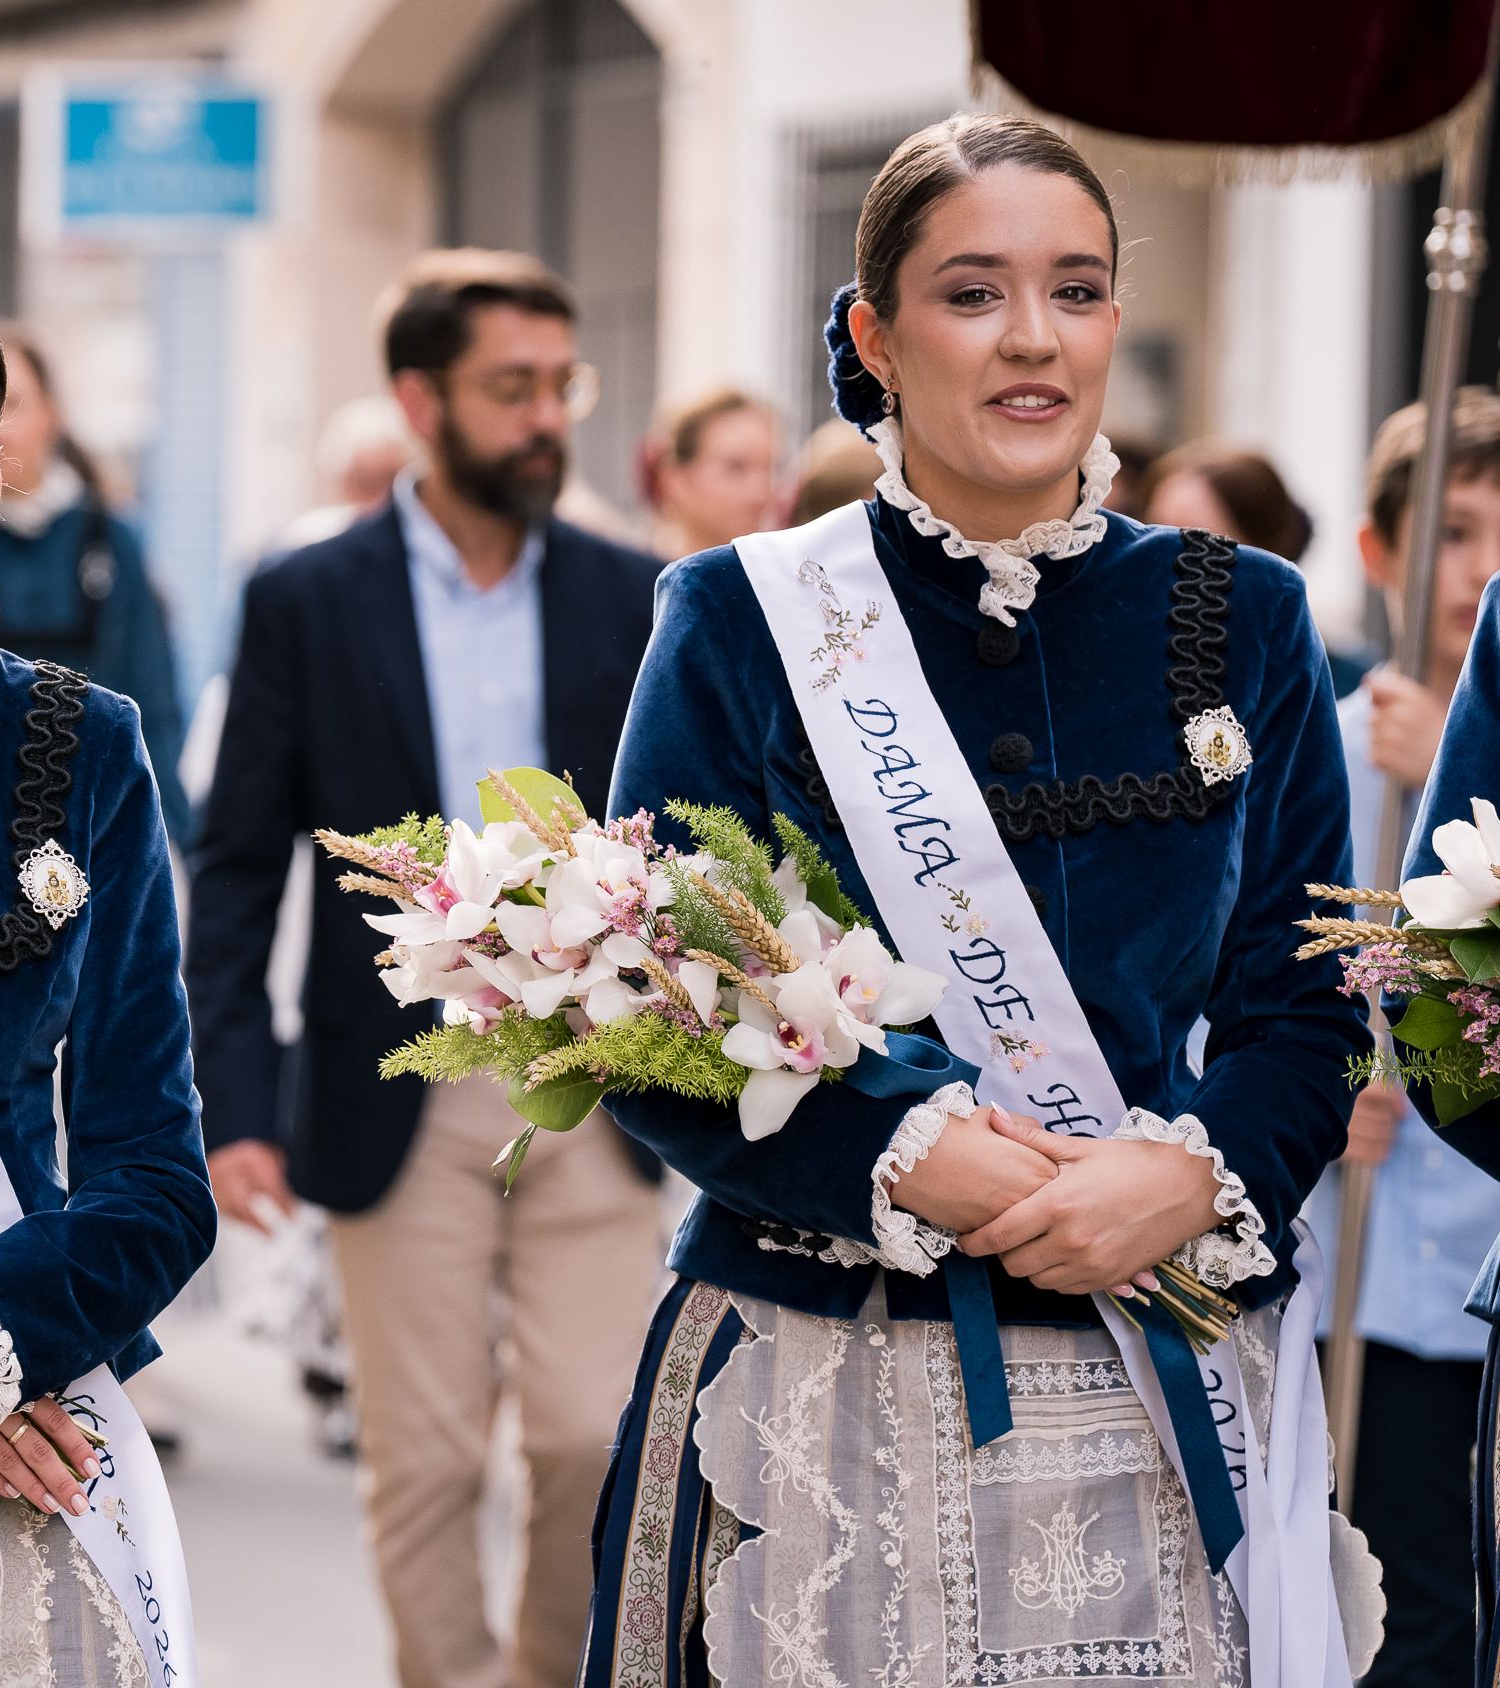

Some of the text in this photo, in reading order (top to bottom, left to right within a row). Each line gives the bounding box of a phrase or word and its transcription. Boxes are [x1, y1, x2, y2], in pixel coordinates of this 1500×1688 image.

[843, 698, 1103, 1138] DAMA DE H
[134, 1569, 178, 1688] 2026
